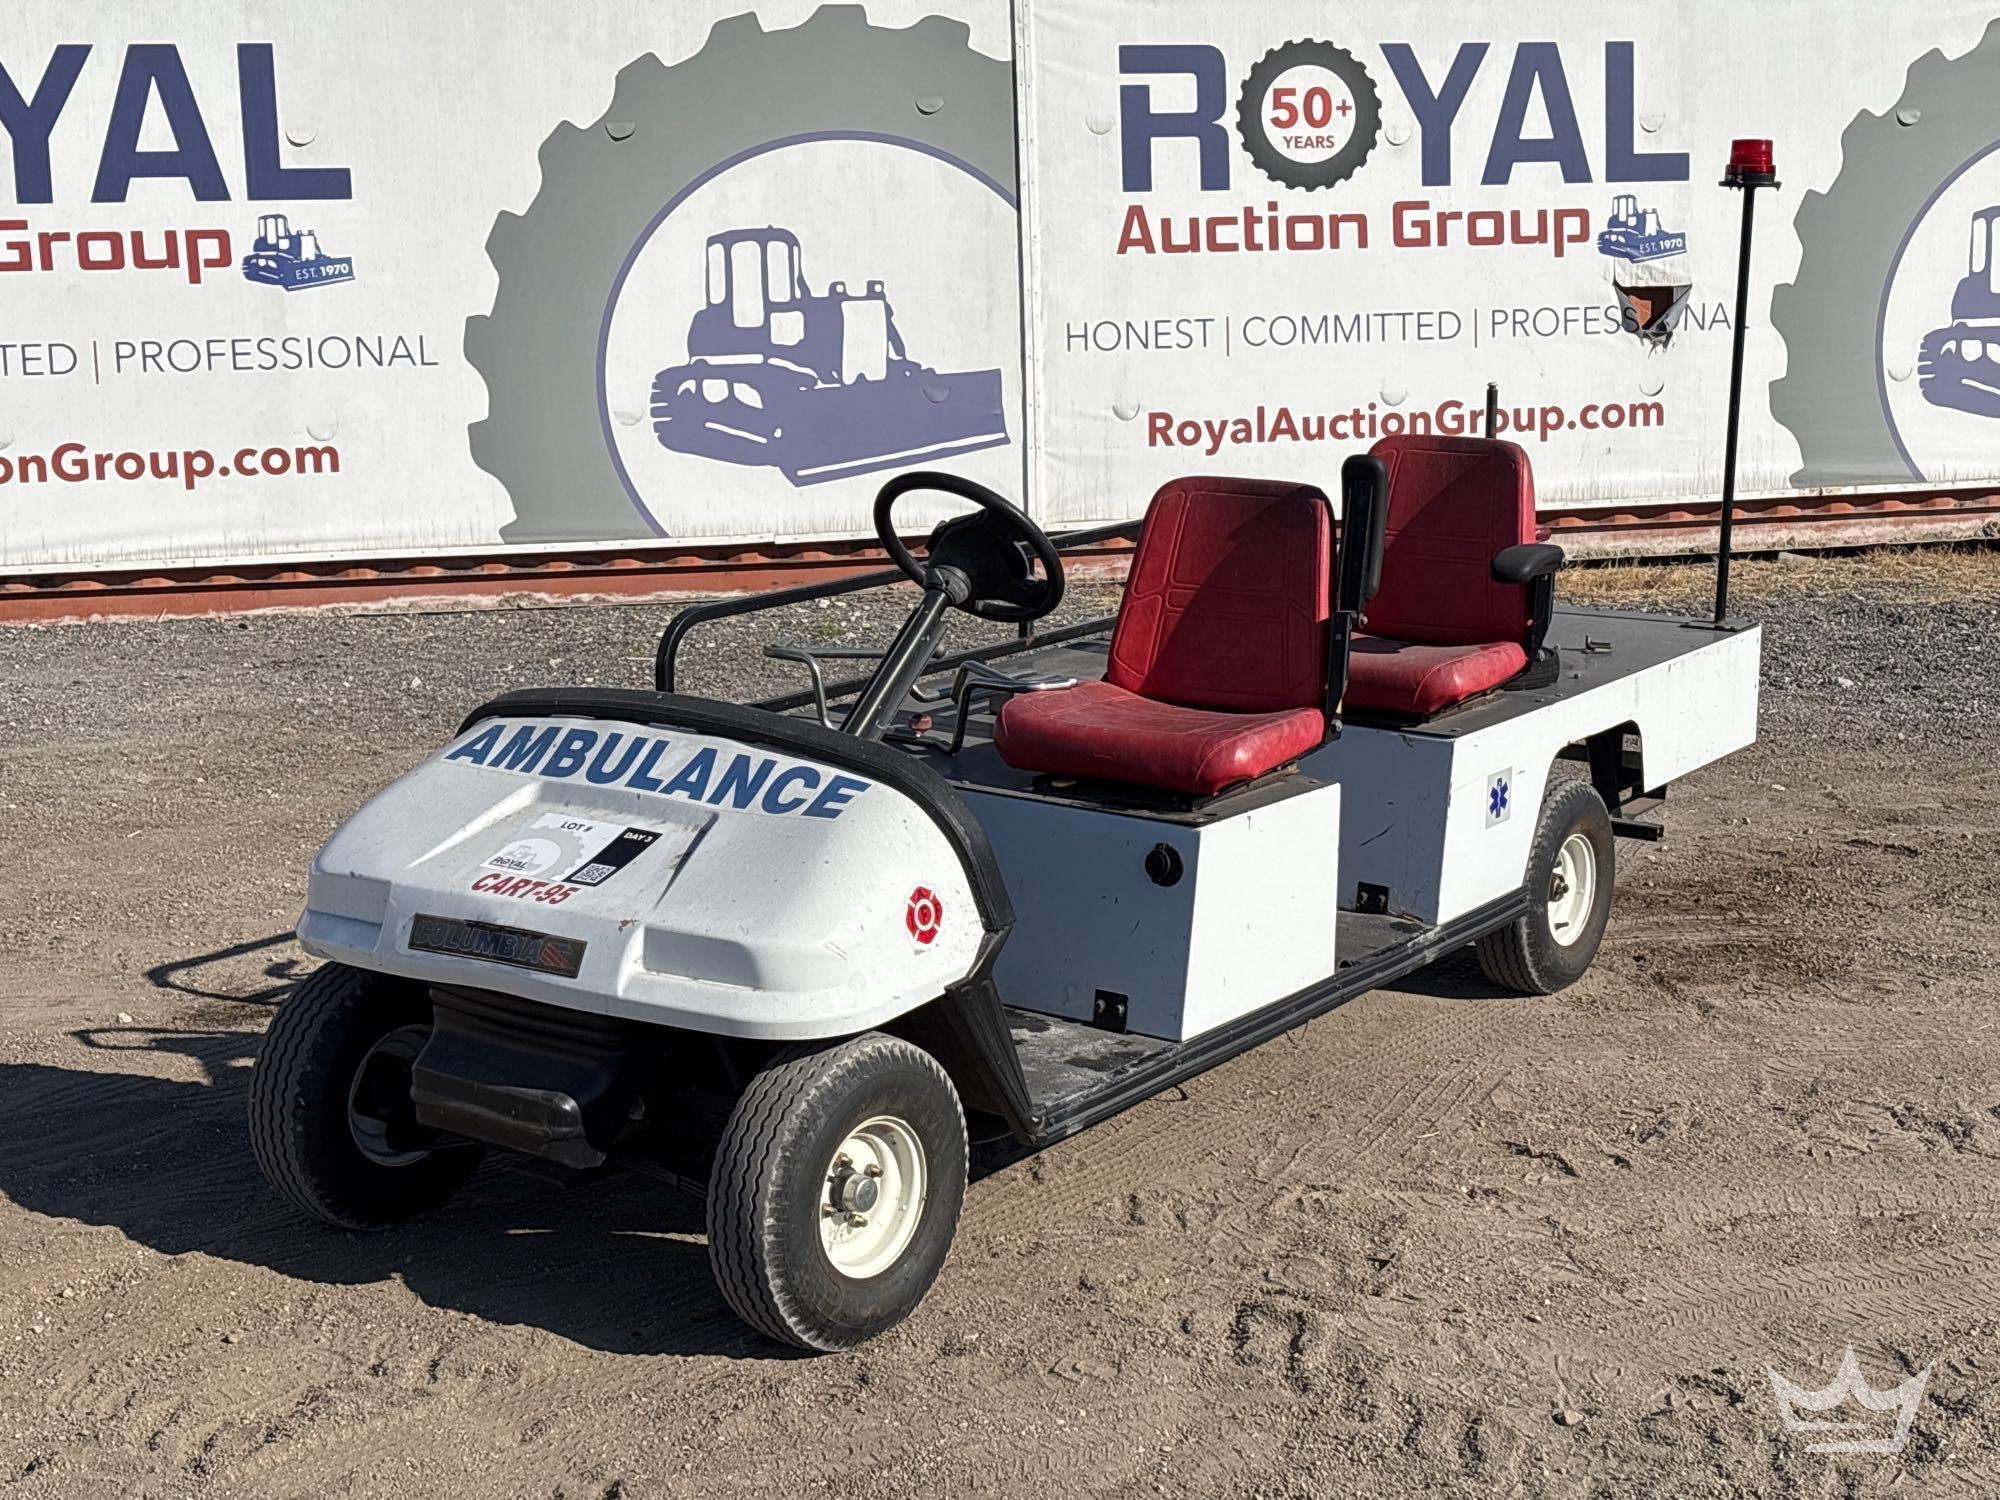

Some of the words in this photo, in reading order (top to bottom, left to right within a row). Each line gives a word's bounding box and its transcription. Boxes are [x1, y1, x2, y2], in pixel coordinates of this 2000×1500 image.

[1270, 86, 1352, 129] 50+
[1282, 135, 1335, 149] YEARS
[1117, 201, 1368, 254] Auction
[1392, 200, 1590, 257] Group
[1639, 242, 1658, 254] EST.
[1659, 237, 1683, 250] 1970
[0, 220, 232, 284] Group
[295, 267, 317, 281] EST.
[319, 262, 350, 276] 1970
[1066, 318, 1215, 352] HONEST
[1242, 310, 1462, 346] COMMITTED
[1491, 302, 1750, 338] PROFESSNA
[115, 335, 439, 374] PROFESSIONAL
[445, 724, 873, 819] AMBULANCE
[560, 821, 585, 831] LOT
[623, 832, 646, 841] DAY
[472, 873, 581, 904] CART-95
[413, 919, 544, 964] COLUMBIA
